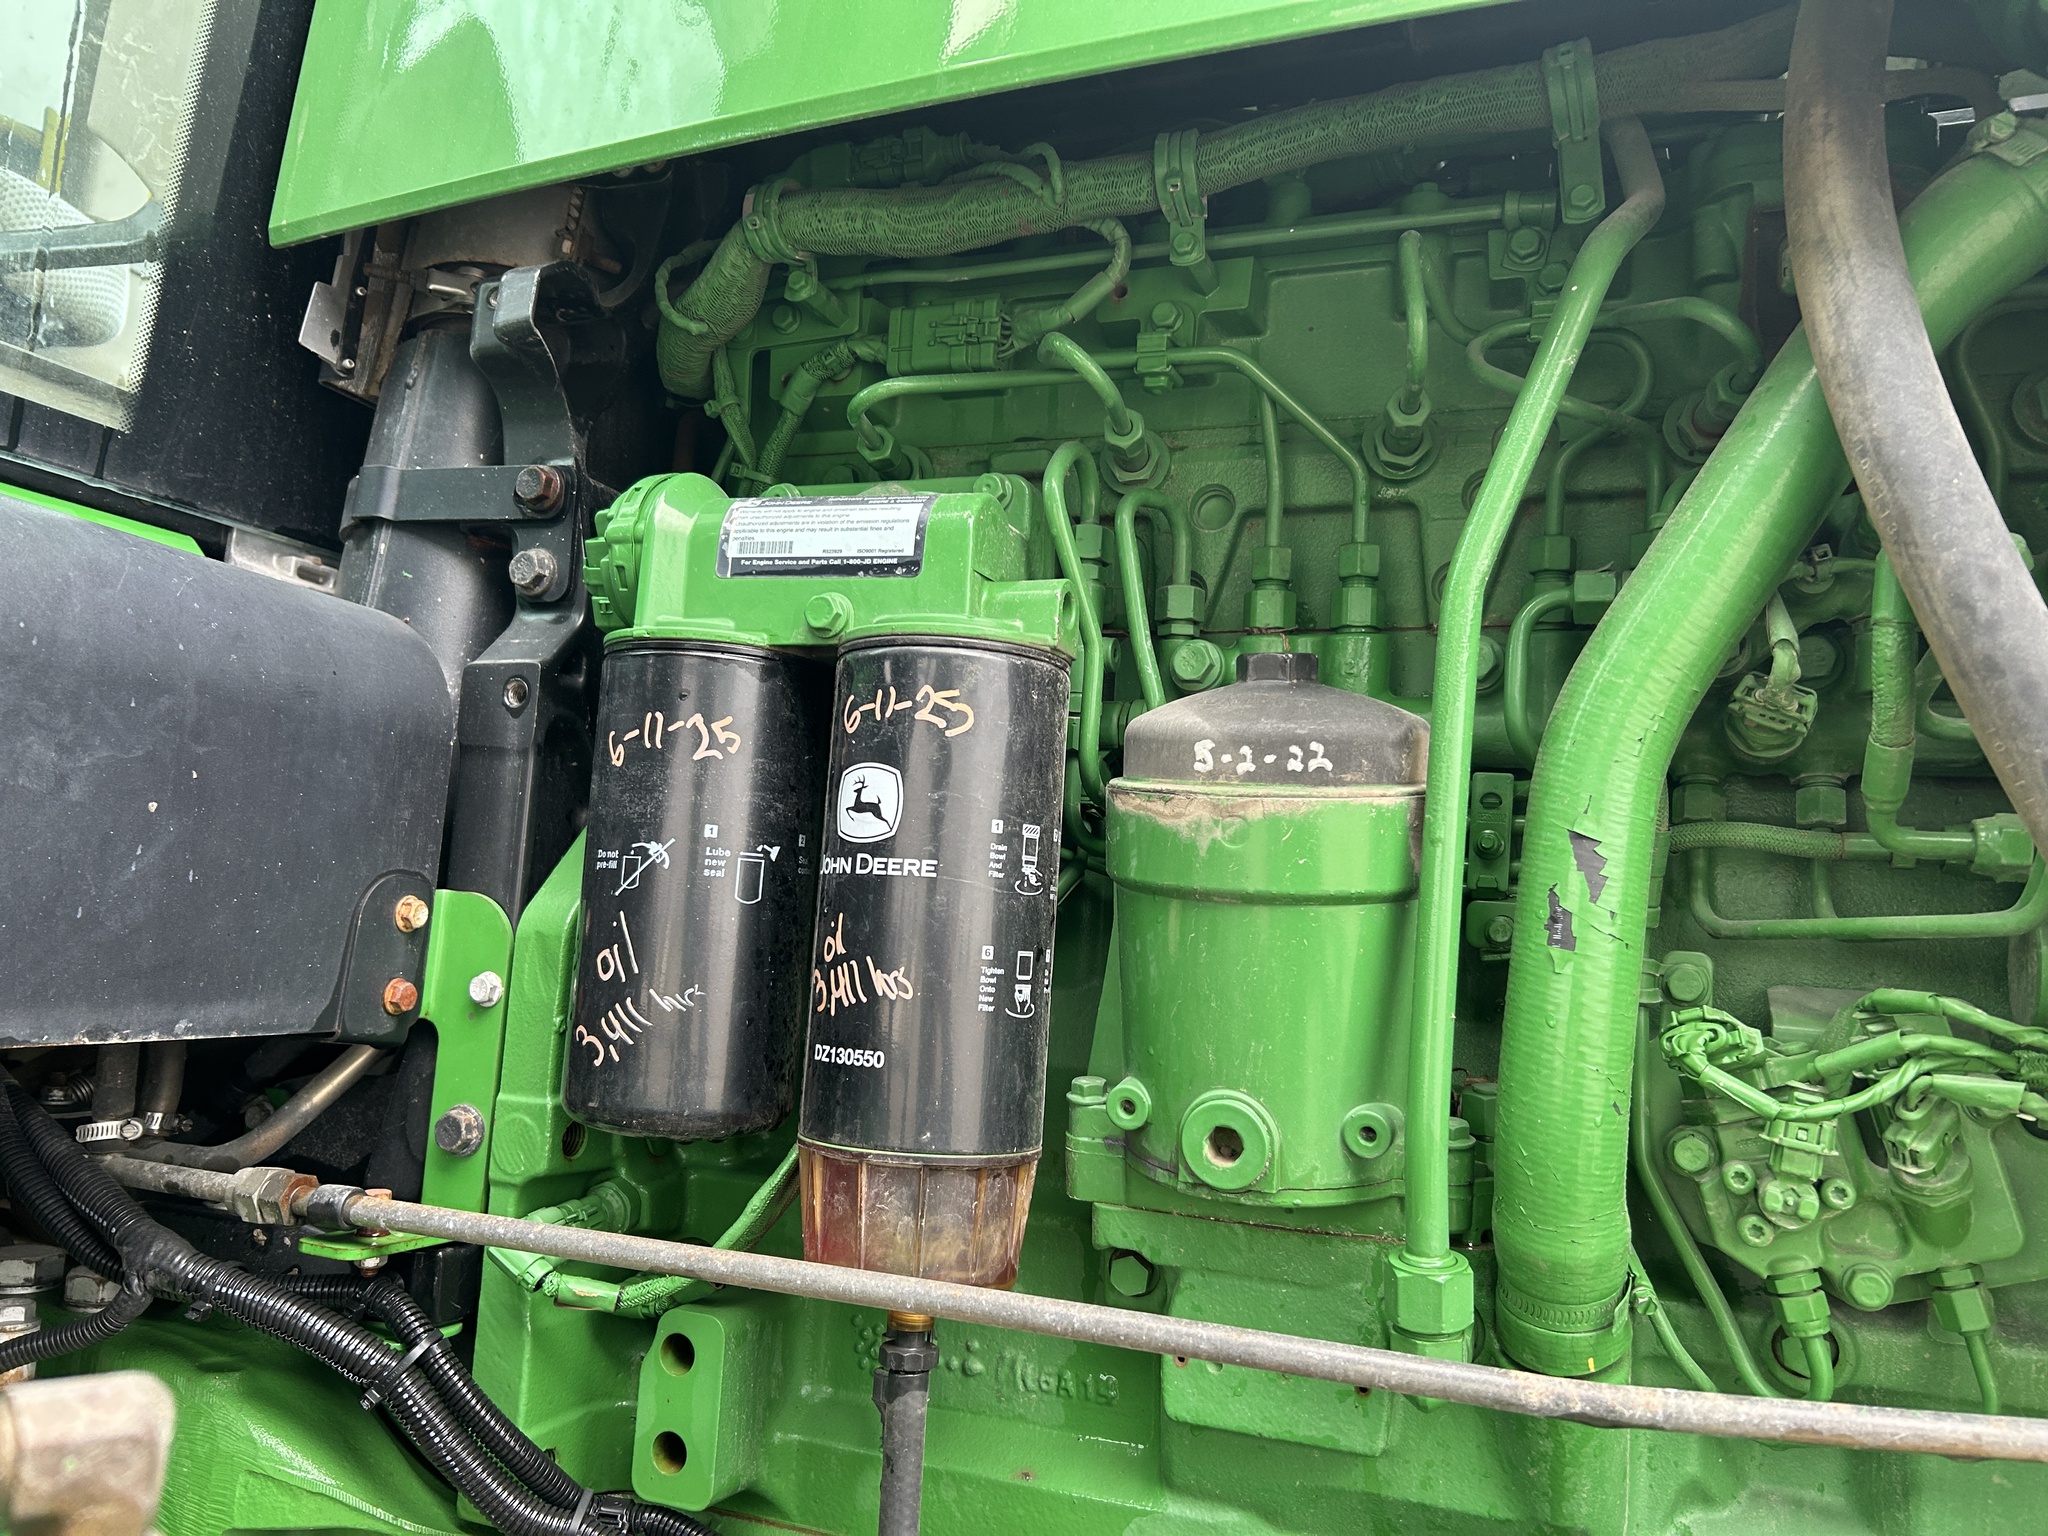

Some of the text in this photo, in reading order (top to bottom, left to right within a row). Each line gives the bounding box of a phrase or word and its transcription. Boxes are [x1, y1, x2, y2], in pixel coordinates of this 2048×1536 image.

[752, 559, 773, 567] Engine
[873, 557, 898, 565] ENGINE
[844, 684, 975, 737] 6-11-25
[608, 711, 741, 767] 6-11-25
[1193, 739, 1333, 775] 5-2-22
[705, 846, 731, 857] Lube
[990, 843, 1008, 852] Drain
[597, 849, 619, 859] Do not
[989, 852, 1006, 861] Bowl
[596, 860, 618, 870] pre-fill
[704, 858, 727, 867] new
[988, 861, 1003, 869] And
[703, 868, 726, 878] seal
[988, 870, 1005, 878] Filter
[823, 912, 847, 962] oil
[596, 910, 639, 982] oil
[980, 966, 1005, 975] Tighten
[980, 975, 997, 984] Bowl
[979, 985, 996, 993] Onto
[978, 994, 994, 1002] New
[977, 1003, 995, 1012] Filter
[814, 1043, 886, 1069] DZ130550
